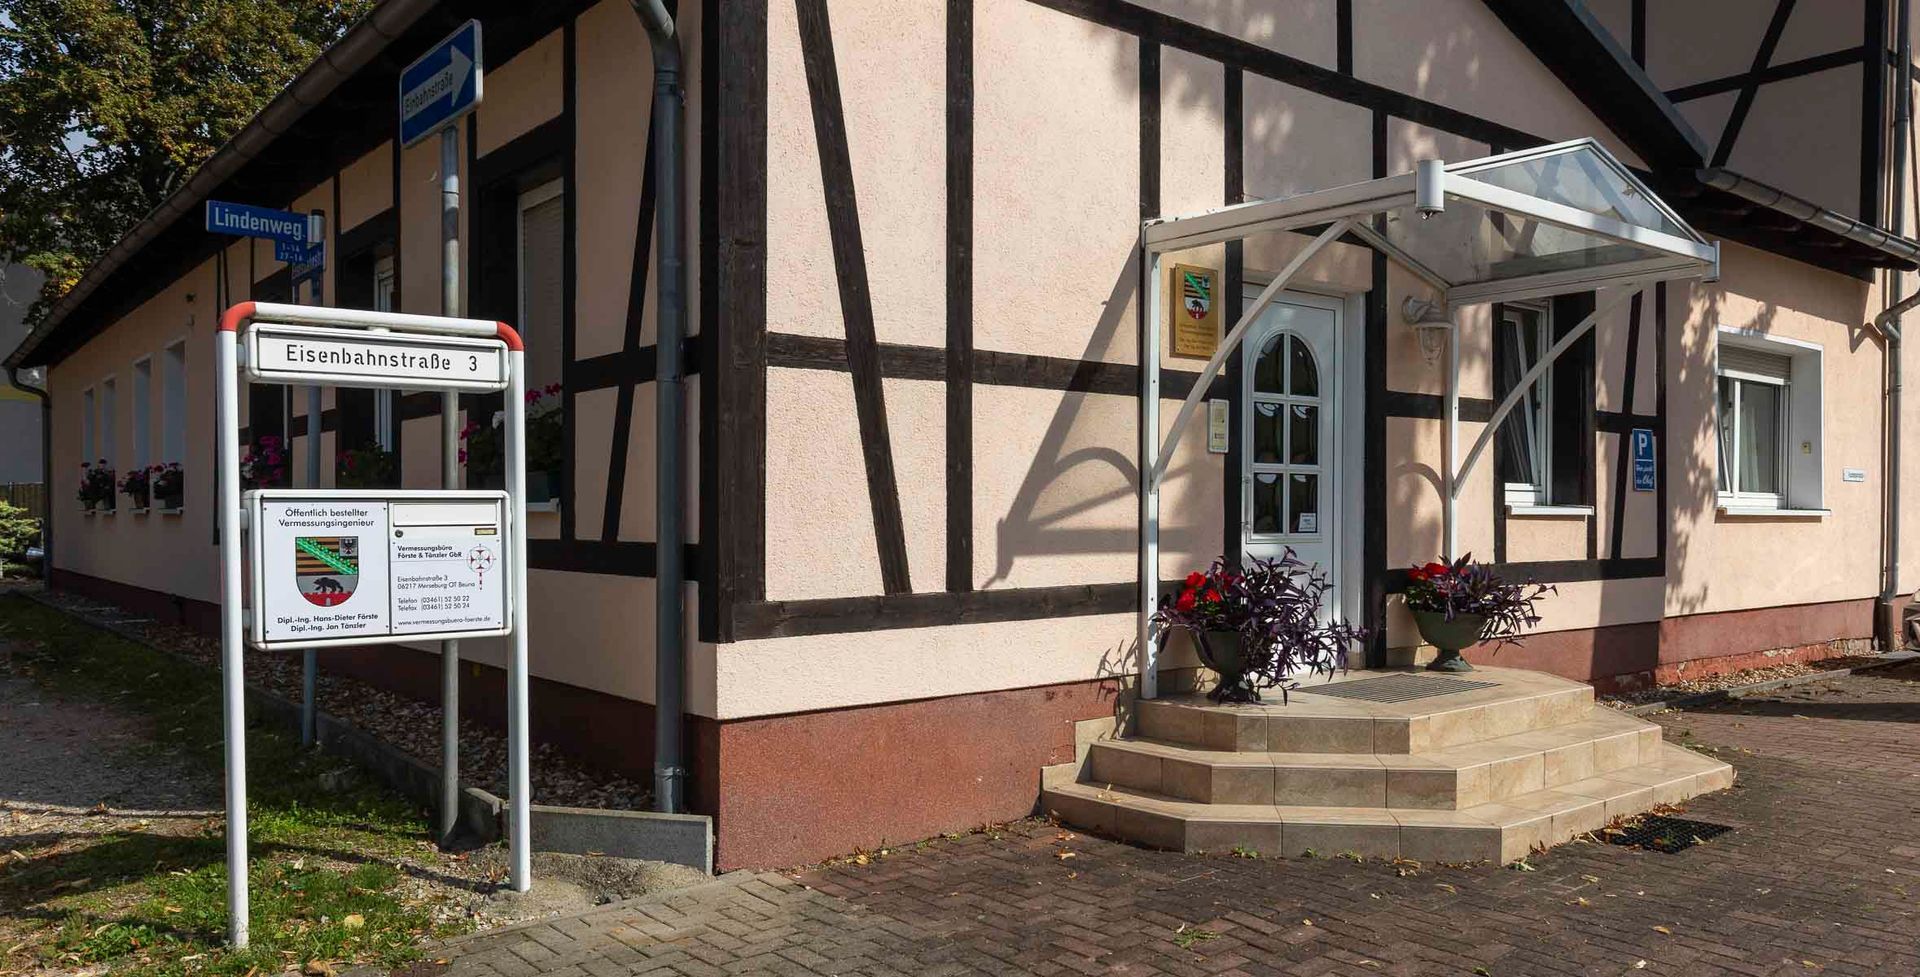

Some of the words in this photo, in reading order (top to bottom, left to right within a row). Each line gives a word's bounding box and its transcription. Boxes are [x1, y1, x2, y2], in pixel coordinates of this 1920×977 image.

[286, 344, 451, 371] Eisenbahnstraße
[469, 355, 478, 372] 3
[1638, 432, 1648, 457] P
[285, 507, 328, 517] Öffentlich
[330, 508, 368, 517] bestellter
[279, 518, 374, 528] Vermessungsingenieur
[397, 544, 453, 552] Vermessungsbüro
[397, 575, 442, 583] Eisenbahnstraße
[277, 616, 311, 625] Dipl.-Ing.
[313, 614, 356, 622] Hans-Dieter
[290, 624, 325, 633] Dipl.-Ing.
